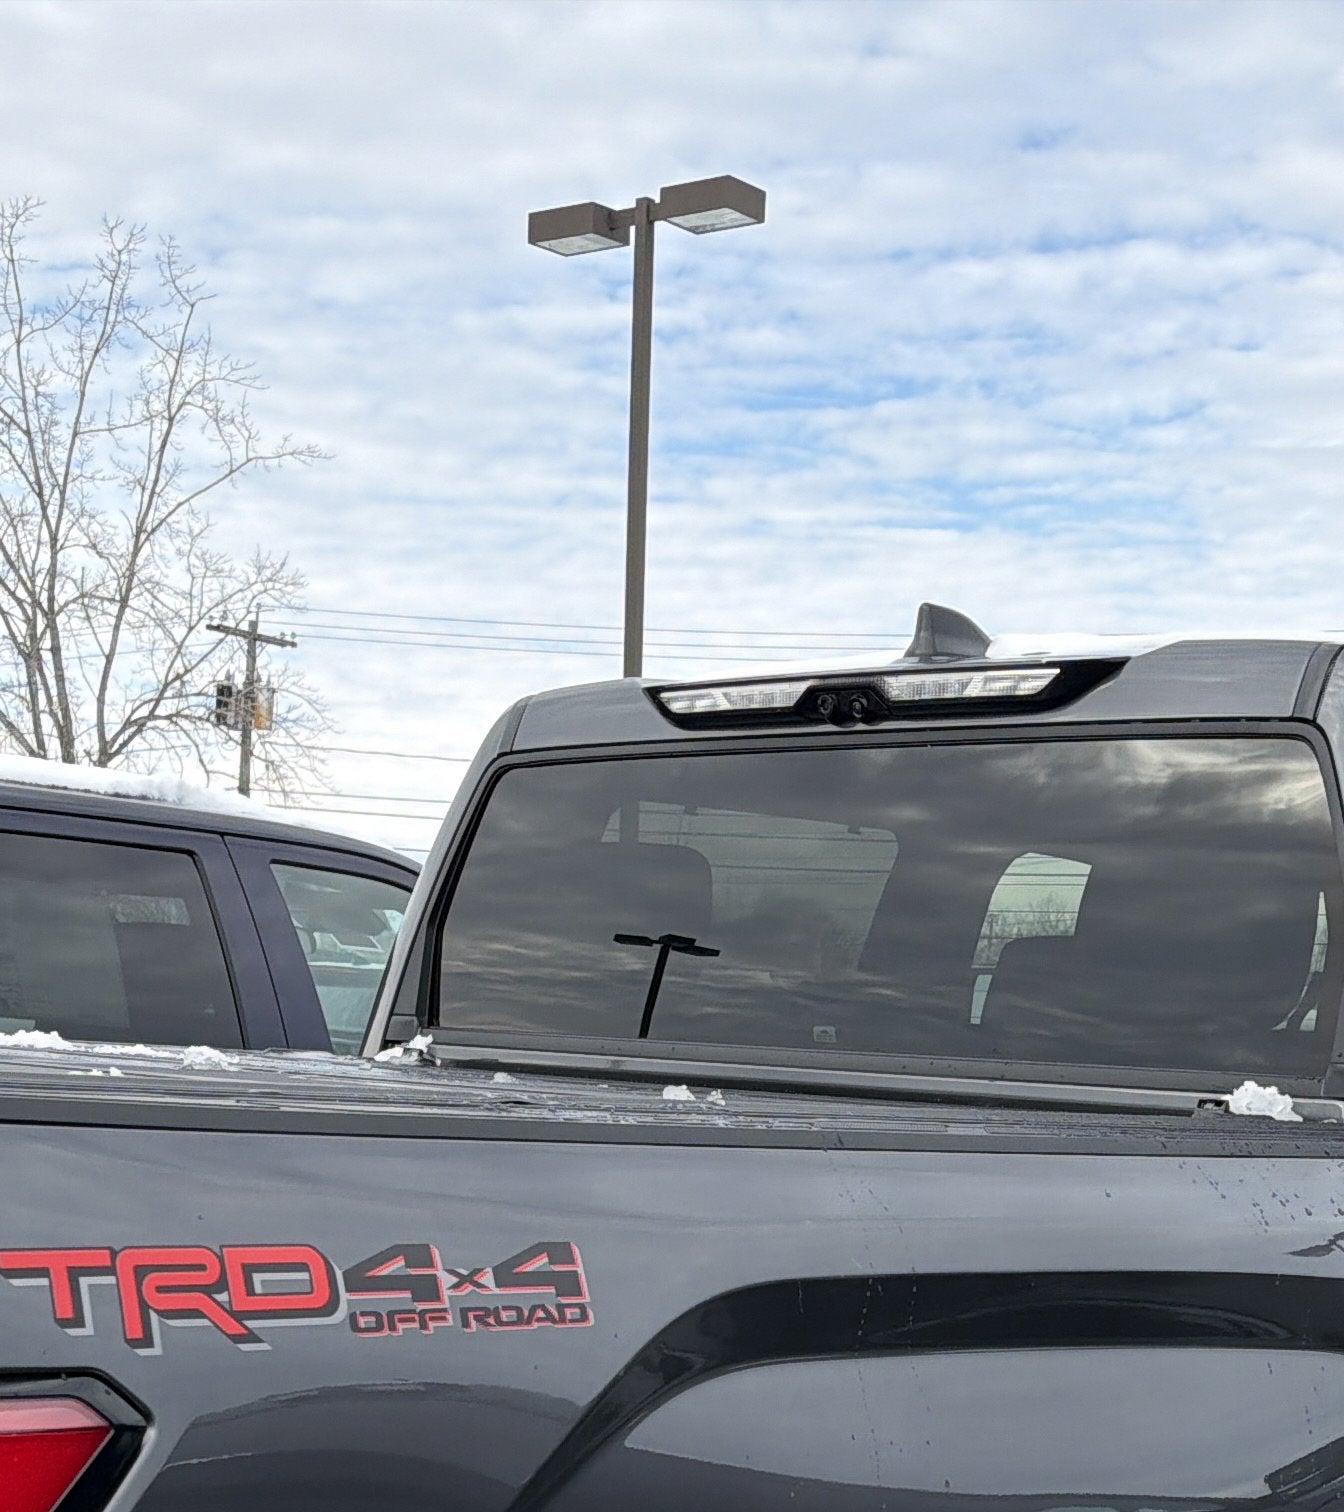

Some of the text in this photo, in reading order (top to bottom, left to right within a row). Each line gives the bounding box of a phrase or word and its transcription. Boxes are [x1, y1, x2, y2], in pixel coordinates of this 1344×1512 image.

[344, 1241, 592, 1306] 4x4
[347, 1302, 595, 1337] OFF ROAD
